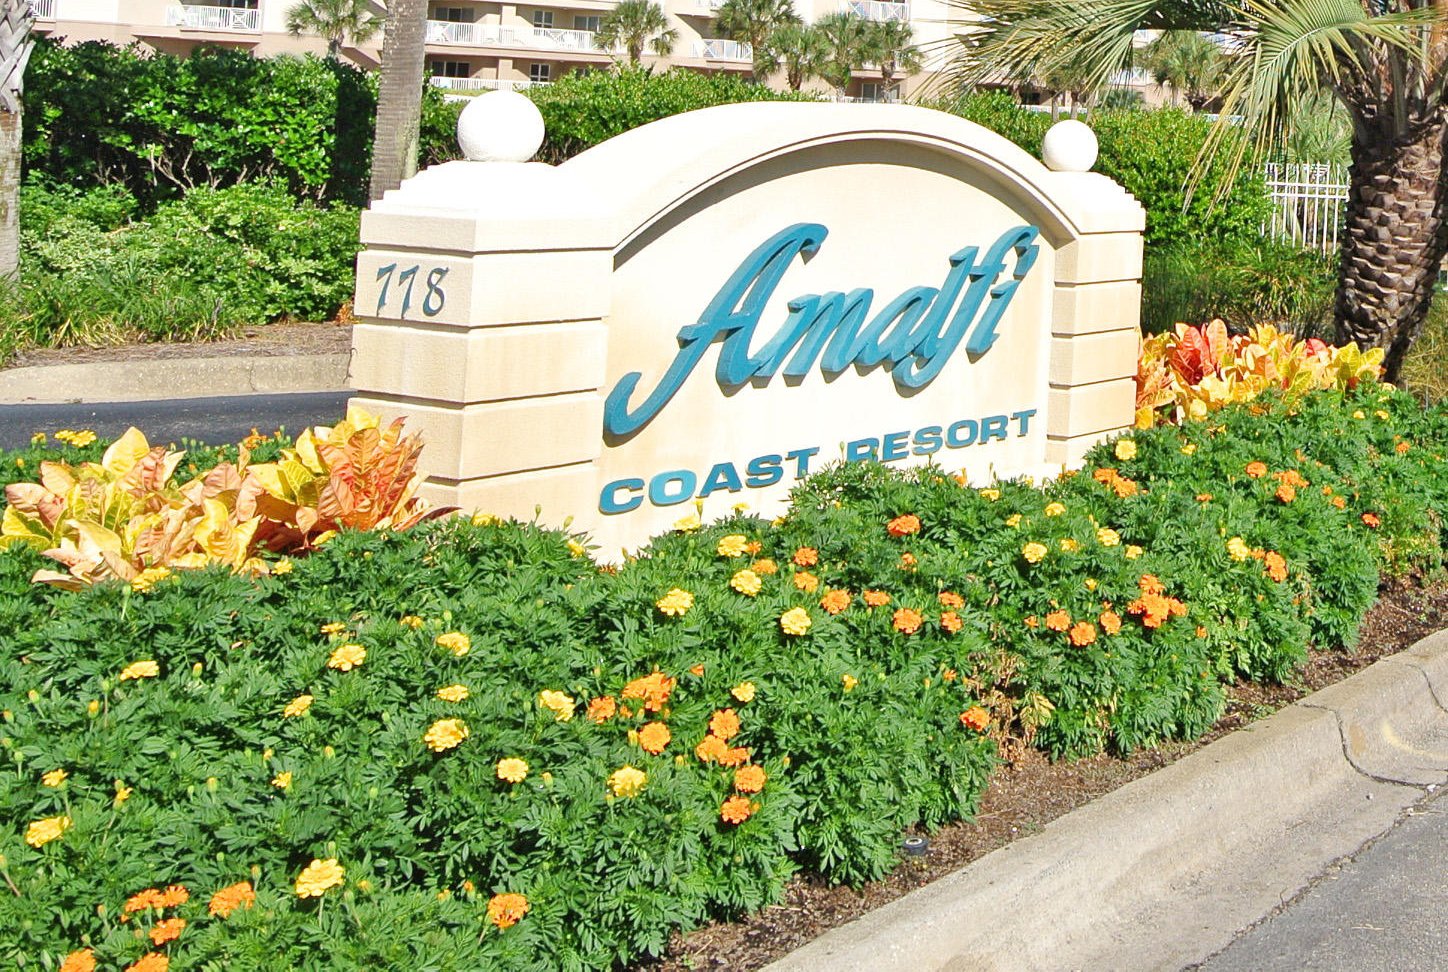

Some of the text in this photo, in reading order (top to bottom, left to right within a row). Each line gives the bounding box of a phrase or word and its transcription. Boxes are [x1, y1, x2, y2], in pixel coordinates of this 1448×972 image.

[376, 262, 450, 320] 778
[603, 223, 1039, 443] Amalfi
[600, 408, 1038, 515] COAST RESORT
